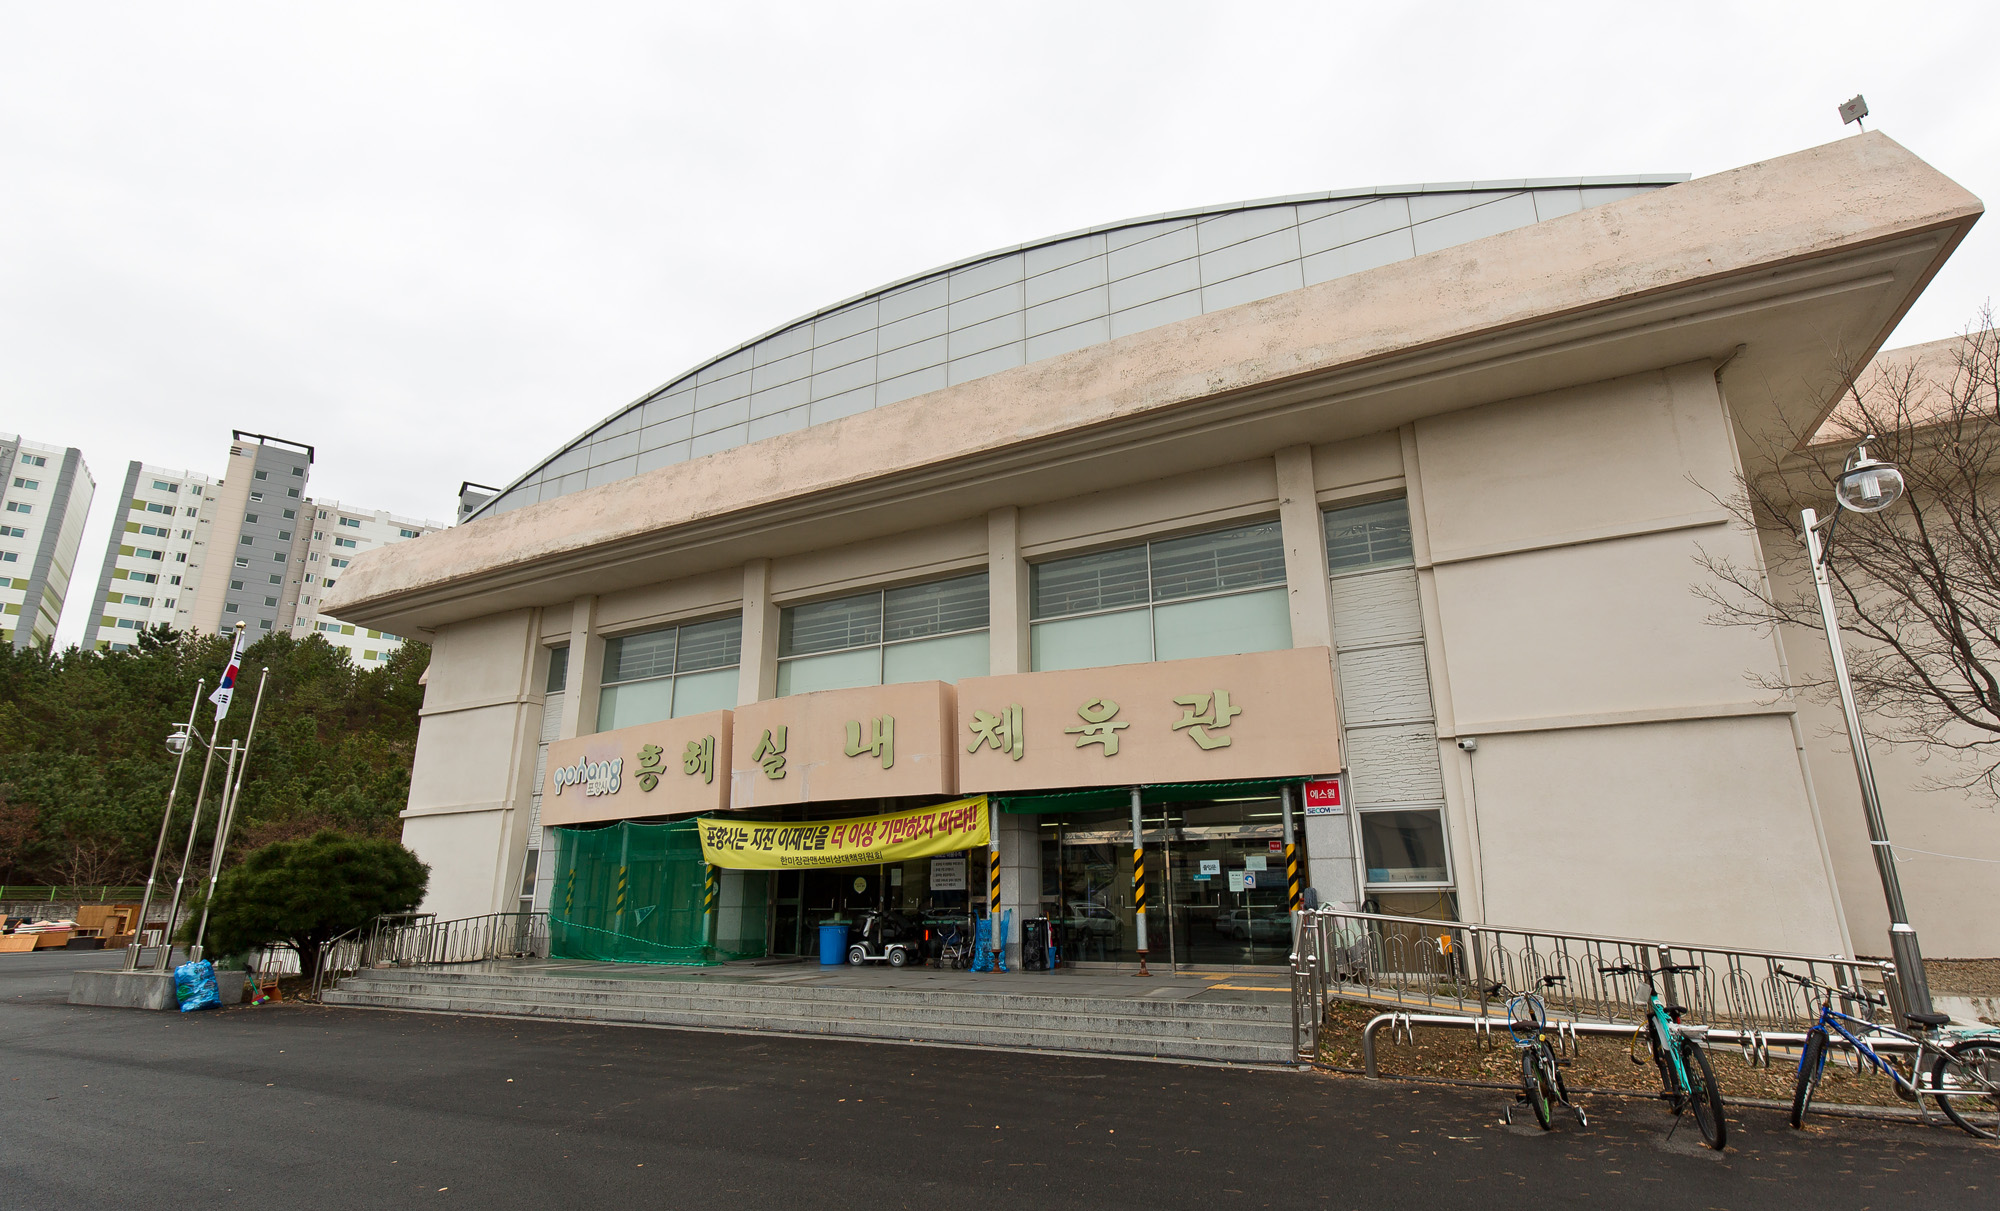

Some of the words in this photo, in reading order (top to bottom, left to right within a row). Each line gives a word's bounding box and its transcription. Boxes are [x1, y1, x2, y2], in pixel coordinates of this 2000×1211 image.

[634, 735, 714, 792] 흥해
[752, 714, 894, 780] 실내
[966, 688, 1241, 761] 체육관
[587, 780, 608, 794] 포항시
[1310, 788, 1335, 799] 에스원
[707, 826, 748, 850] 포항시는
[751, 828, 777, 850] 지진
[778, 826, 829, 850] 이재민을
[831, 825, 848, 849] 더
[849, 822, 877, 848] 이상
[879, 813, 935, 844] 기만하지
[938, 805, 977, 834] 마라!!
[780, 851, 883, 866] 한미장관맨션비상대책위원회
